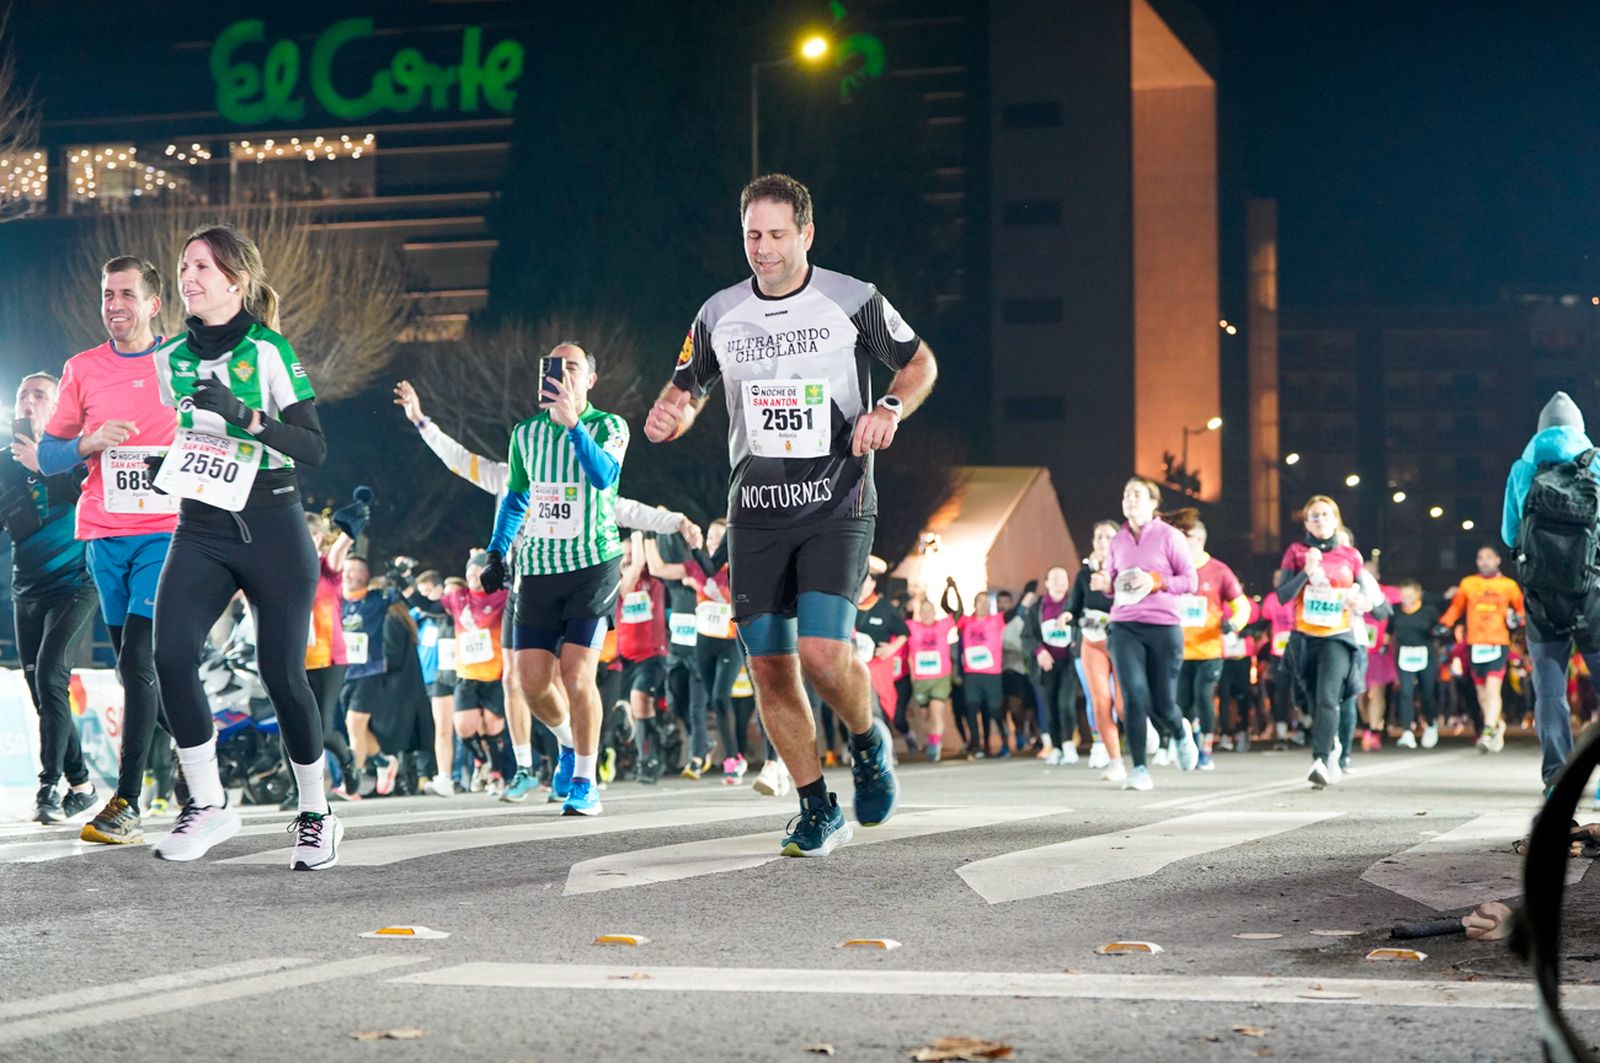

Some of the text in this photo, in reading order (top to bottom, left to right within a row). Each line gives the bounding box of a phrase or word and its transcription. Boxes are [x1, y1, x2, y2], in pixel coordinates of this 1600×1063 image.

[209, 18, 524, 124] El Corte
[727, 327, 830, 353] ULTRAFONDO
[735, 341, 818, 363] CHICLANA
[753, 398, 768, 406] SAN
[761, 388, 797, 396] NOCHE DE
[762, 408, 813, 431] 2551
[111, 461, 125, 469] SAN
[180, 452, 239, 483] 2550
[741, 477, 832, 509] NOCTURNIS
[538, 502, 571, 519] 2549
